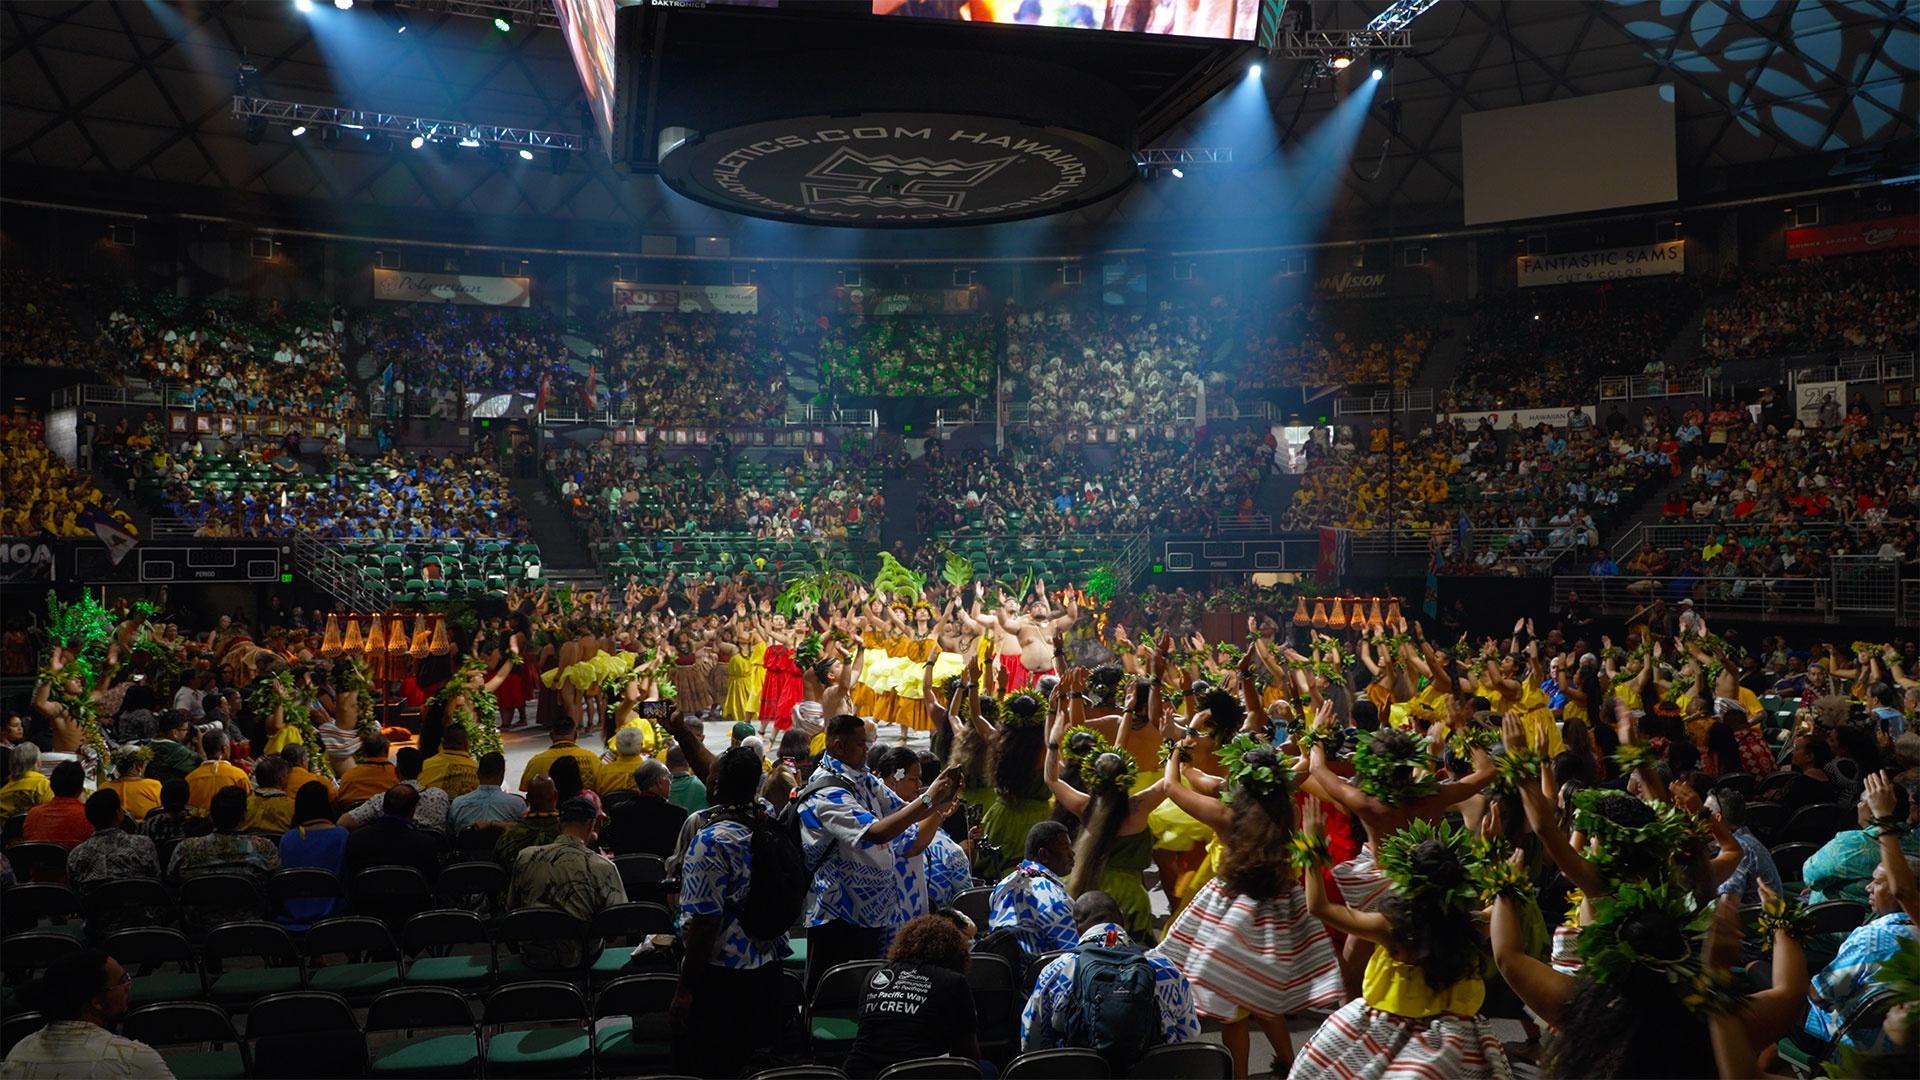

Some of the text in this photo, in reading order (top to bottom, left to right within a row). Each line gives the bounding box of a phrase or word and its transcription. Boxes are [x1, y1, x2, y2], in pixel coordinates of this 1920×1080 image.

[651, 0, 707, 9] DAKTRONICS
[1524, 247, 1678, 274] FANTASTIC SAMS
[1556, 273, 1581, 283] CUT
[1598, 267, 1643, 281] COLOR
[878, 991, 905, 999] Pacific
[906, 992, 928, 1004] Way
[865, 1001, 920, 1015] TV CREW
